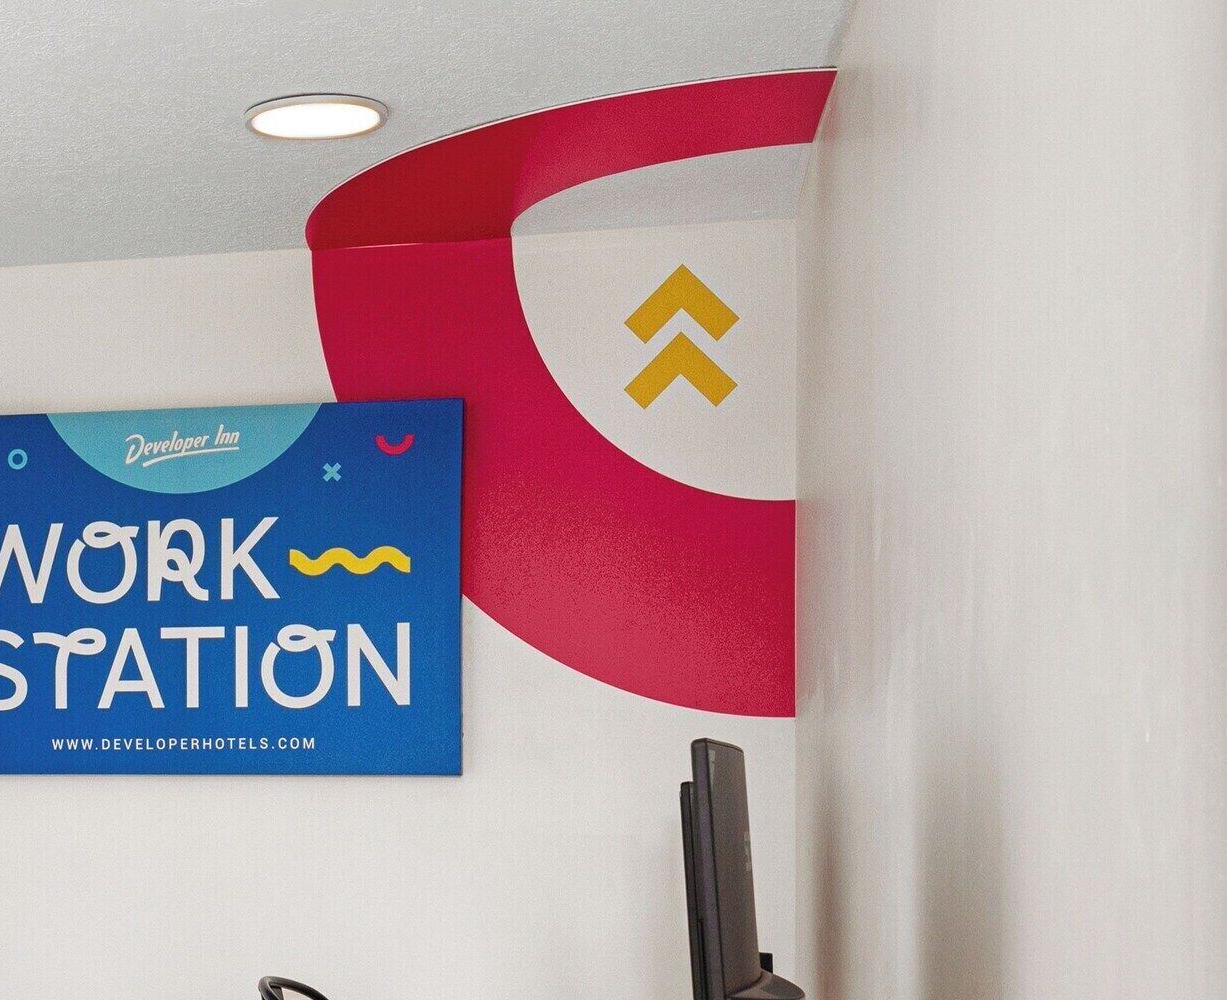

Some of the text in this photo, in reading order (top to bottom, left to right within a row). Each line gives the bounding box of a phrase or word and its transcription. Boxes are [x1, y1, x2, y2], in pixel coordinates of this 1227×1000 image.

[125, 424, 240, 465] Developer Inn
[52, 737, 316, 750] WWW.DEVELOPERHOTELS.COM
